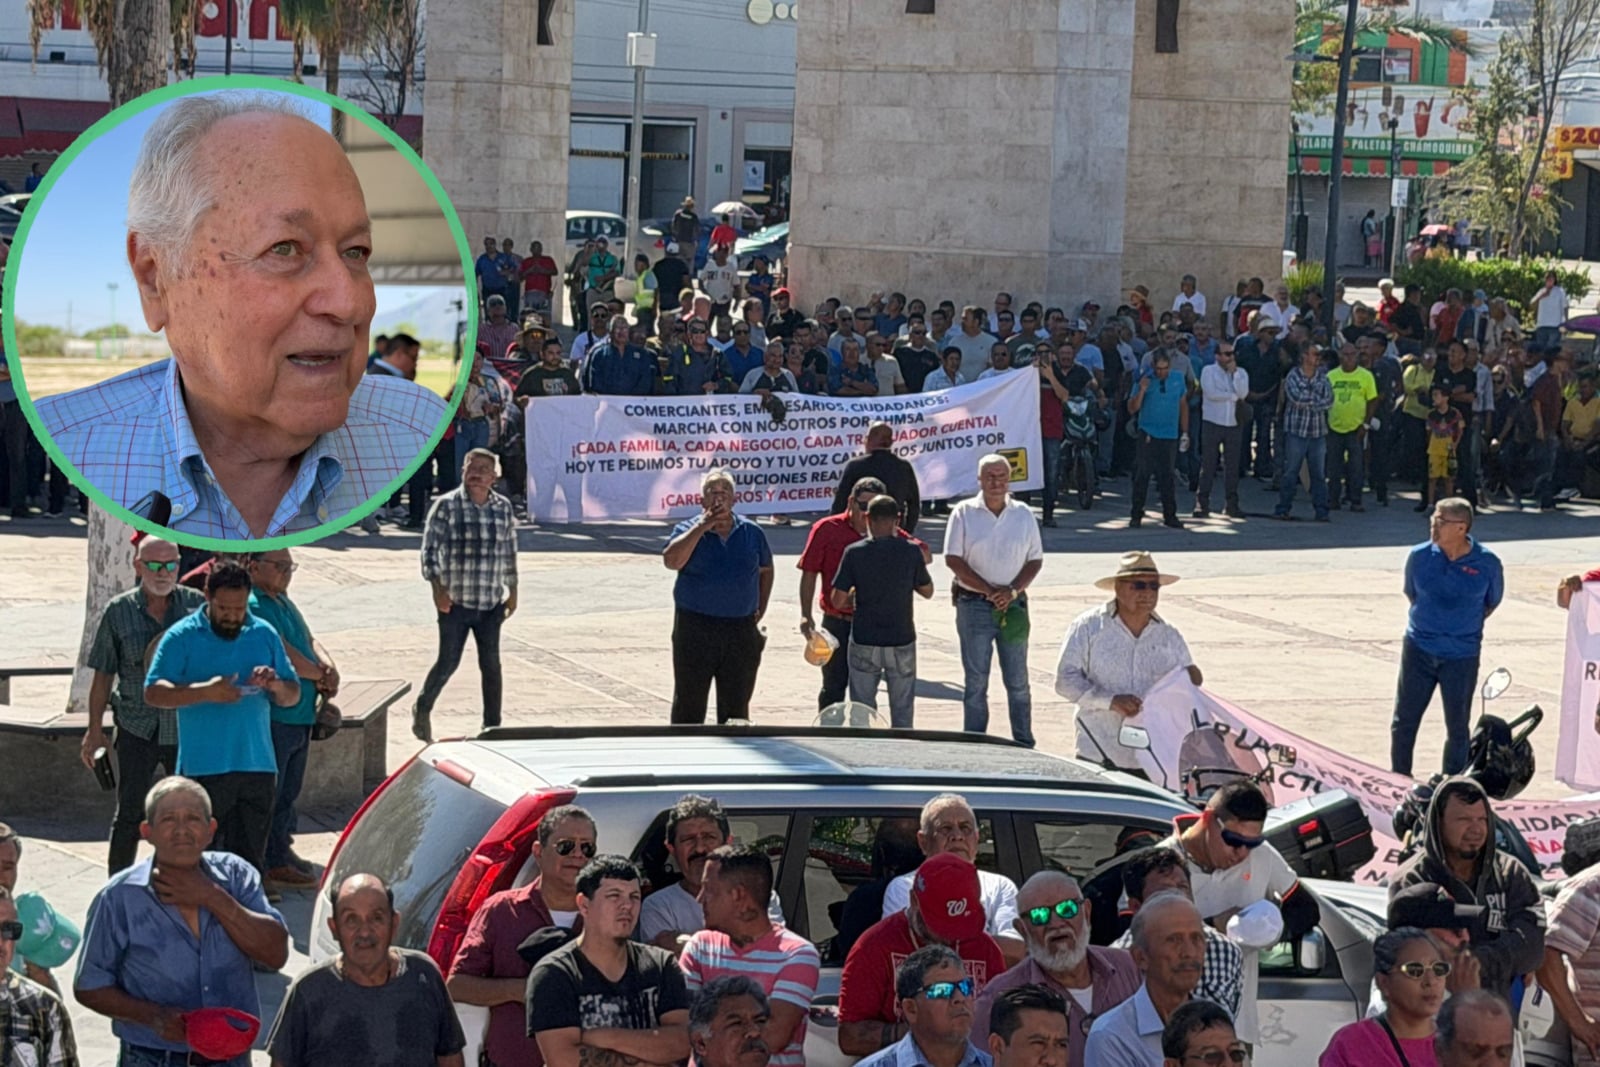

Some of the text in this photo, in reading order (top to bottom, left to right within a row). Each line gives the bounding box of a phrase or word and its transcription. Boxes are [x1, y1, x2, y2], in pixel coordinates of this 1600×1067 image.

[624, 403, 741, 418] COMERCIANTES,
[851, 395, 950, 413] CIUDADANOS:
[620, 440, 681, 453] FAMILIA,
[684, 440, 726, 452] CADA
[730, 437, 800, 452] NEGOCIO,
[803, 435, 843, 449] CADA
[940, 415, 998, 433] CUENTA!
[653, 422, 718, 435] MARCHA
[720, 421, 753, 434] CON
[757, 417, 837, 433] NOSOTROS
[841, 416, 870, 429] POR
[565, 461, 596, 474] HOY
[598, 460, 615, 472] TE
[618, 457, 684, 471] PEDIMOS
[687, 457, 706, 469] TU
[709, 455, 762, 469] APOYO
[765, 455, 775, 469] Y
[777, 455, 796, 468] TU
[799, 454, 829, 467] VOZ
[919, 436, 973, 454] JUNTOS
[977, 432, 1006, 447] POR
[766, 489, 776, 502] Y
